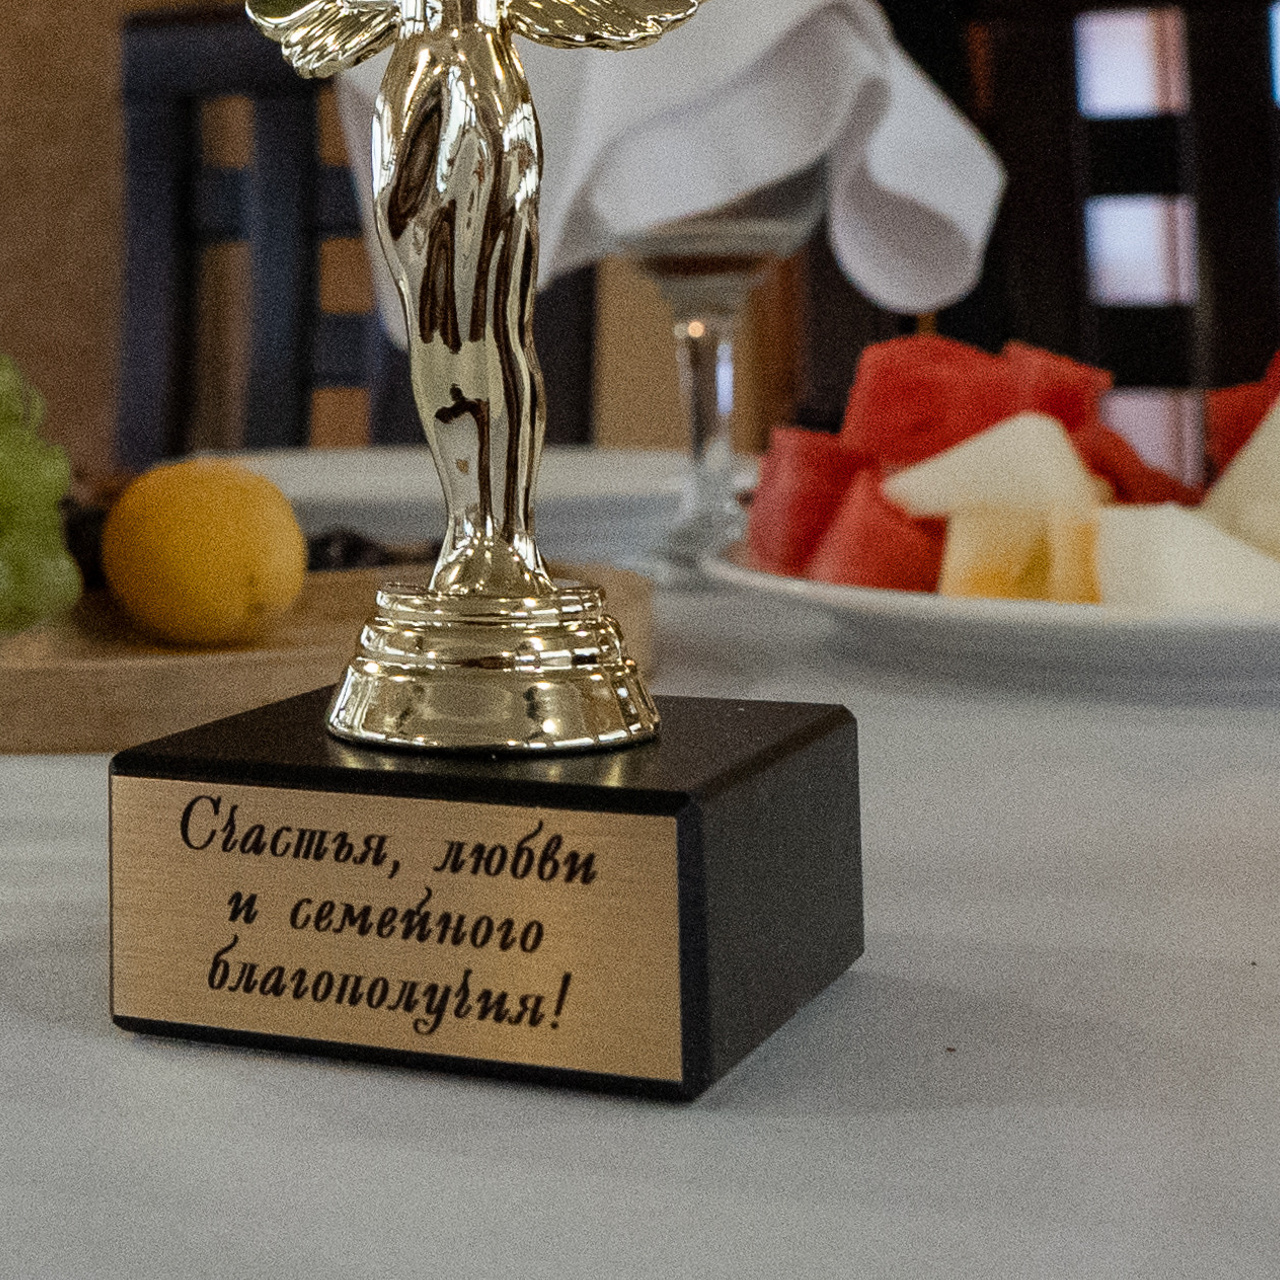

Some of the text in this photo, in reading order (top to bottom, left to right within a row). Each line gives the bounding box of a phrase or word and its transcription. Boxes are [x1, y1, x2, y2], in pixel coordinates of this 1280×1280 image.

[180, 794, 597, 886] Счастья, любви
[226, 887, 545, 954] и семейного
[207, 934, 573, 1036] благополучия!
